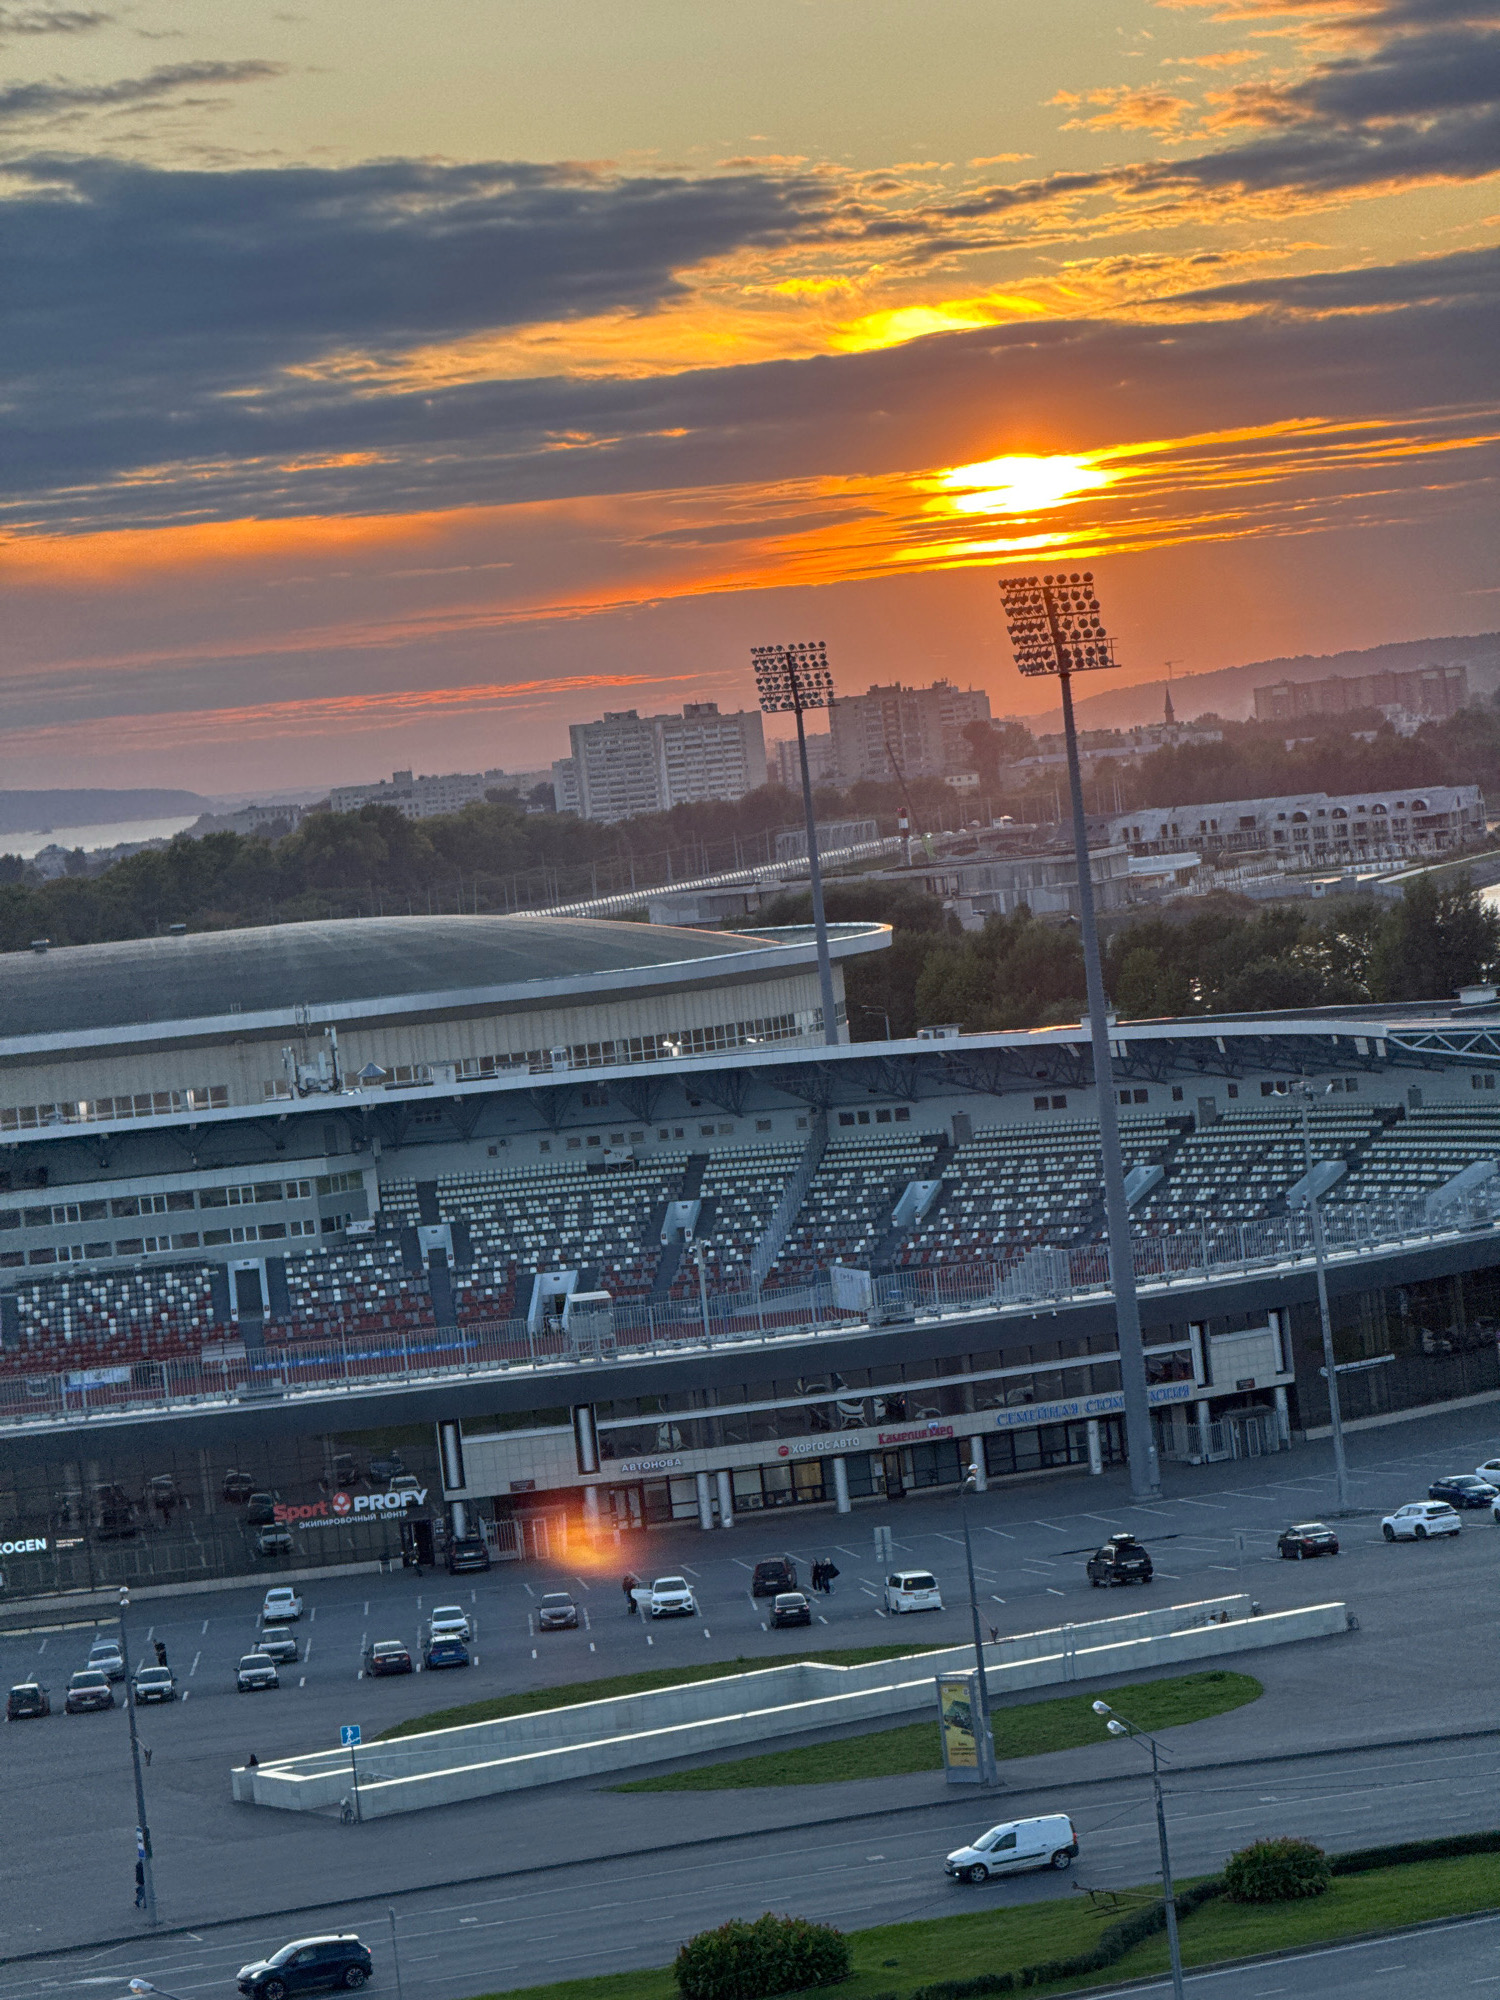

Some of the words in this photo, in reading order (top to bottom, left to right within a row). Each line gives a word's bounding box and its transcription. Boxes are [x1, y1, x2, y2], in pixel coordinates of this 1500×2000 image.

[997, 1402, 1078, 1426] СЕМЕЙНАЯ
[1085, 1384, 1190, 1413] СТОМЛОГИЯ
[791, 1441, 831, 1454] ХОРГОС
[832, 1437, 860, 1448] АВТО
[878, 1428, 928, 1445] Камелия
[621, 1458, 682, 1472] АВТОНОВА
[273, 1501, 328, 1523] Sport
[353, 1488, 428, 1512] PROFY
[299, 1513, 377, 1529] ЭКИПИРОВОЧНЫЙ
[380, 1510, 408, 1520] ЦЕНТР
